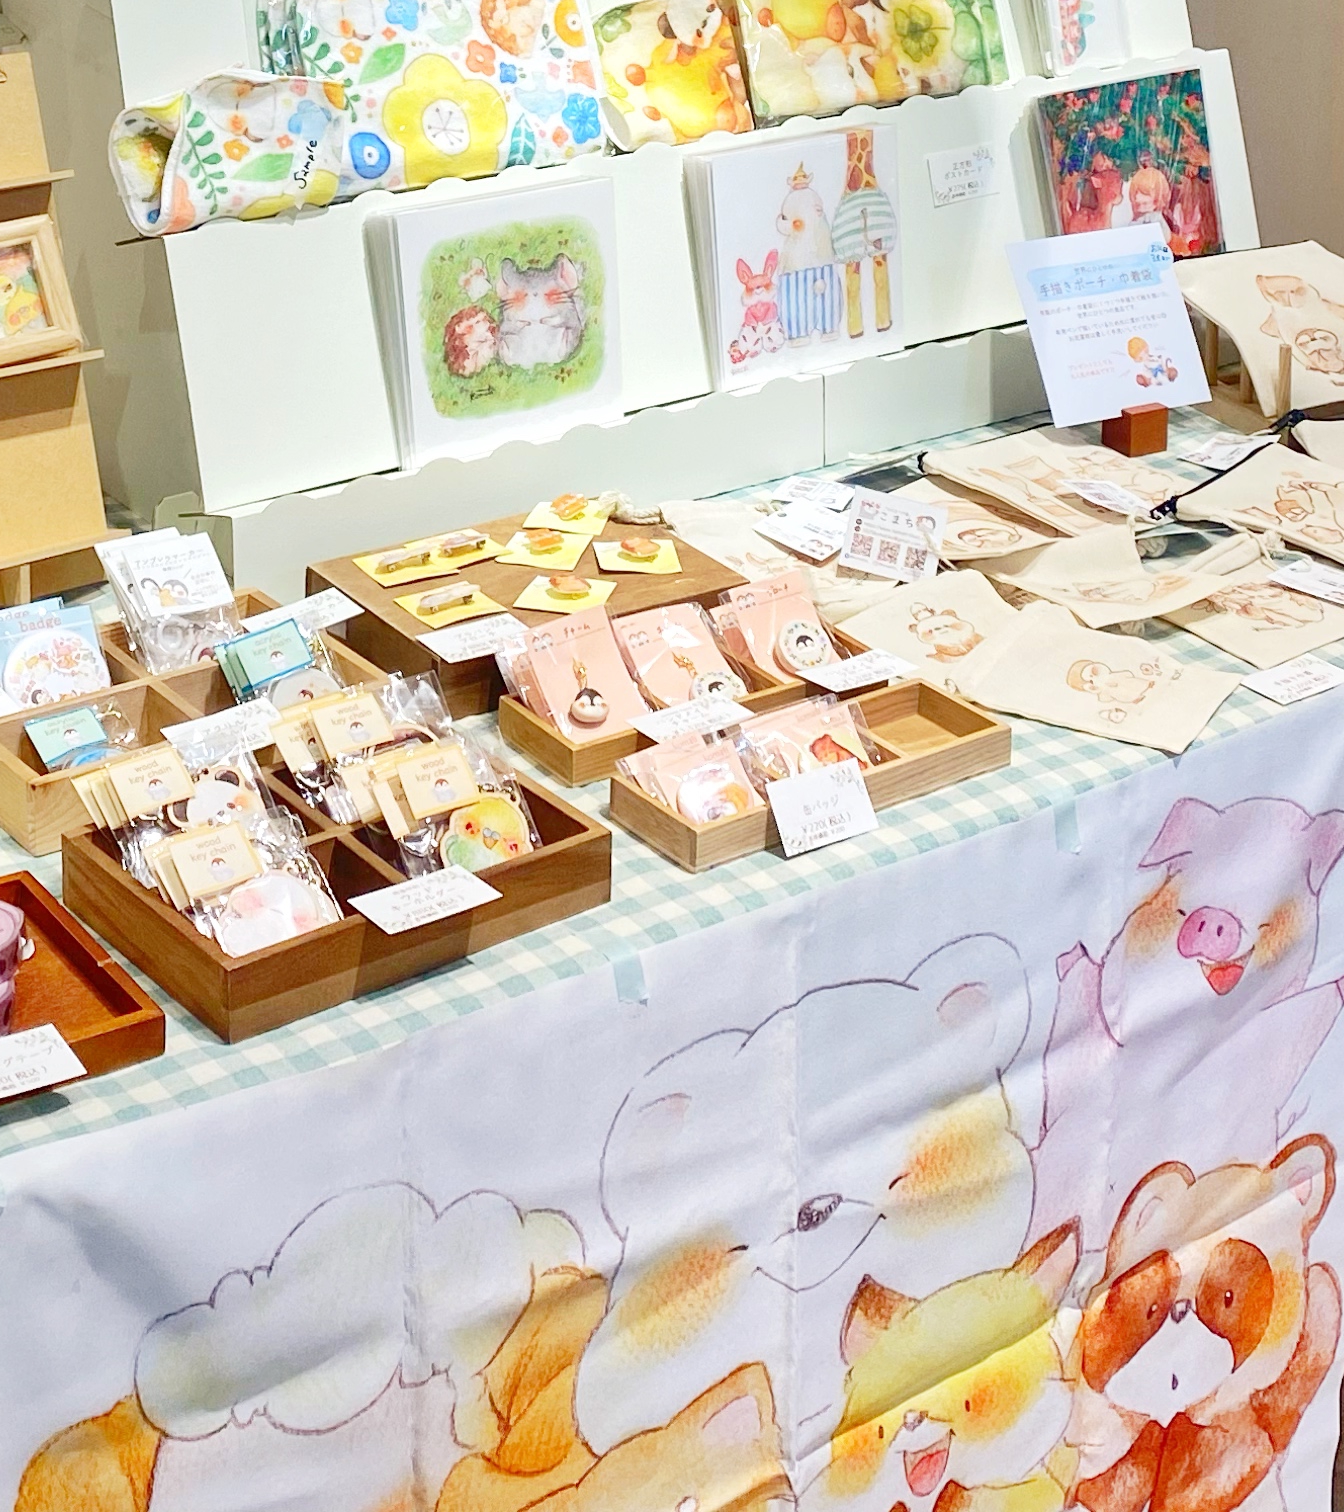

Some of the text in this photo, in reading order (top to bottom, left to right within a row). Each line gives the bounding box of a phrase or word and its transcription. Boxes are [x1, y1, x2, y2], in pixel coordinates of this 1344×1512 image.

[18, 616, 62, 632] badge
[337, 703, 359, 714] wood
[330, 710, 373, 726] key chain
[134, 760, 159, 773] wood
[421, 758, 445, 769] wood
[128, 766, 172, 785] key chain
[415, 766, 458, 782] key chain
[195, 836, 222, 849] wood
[189, 842, 236, 862] key chain
